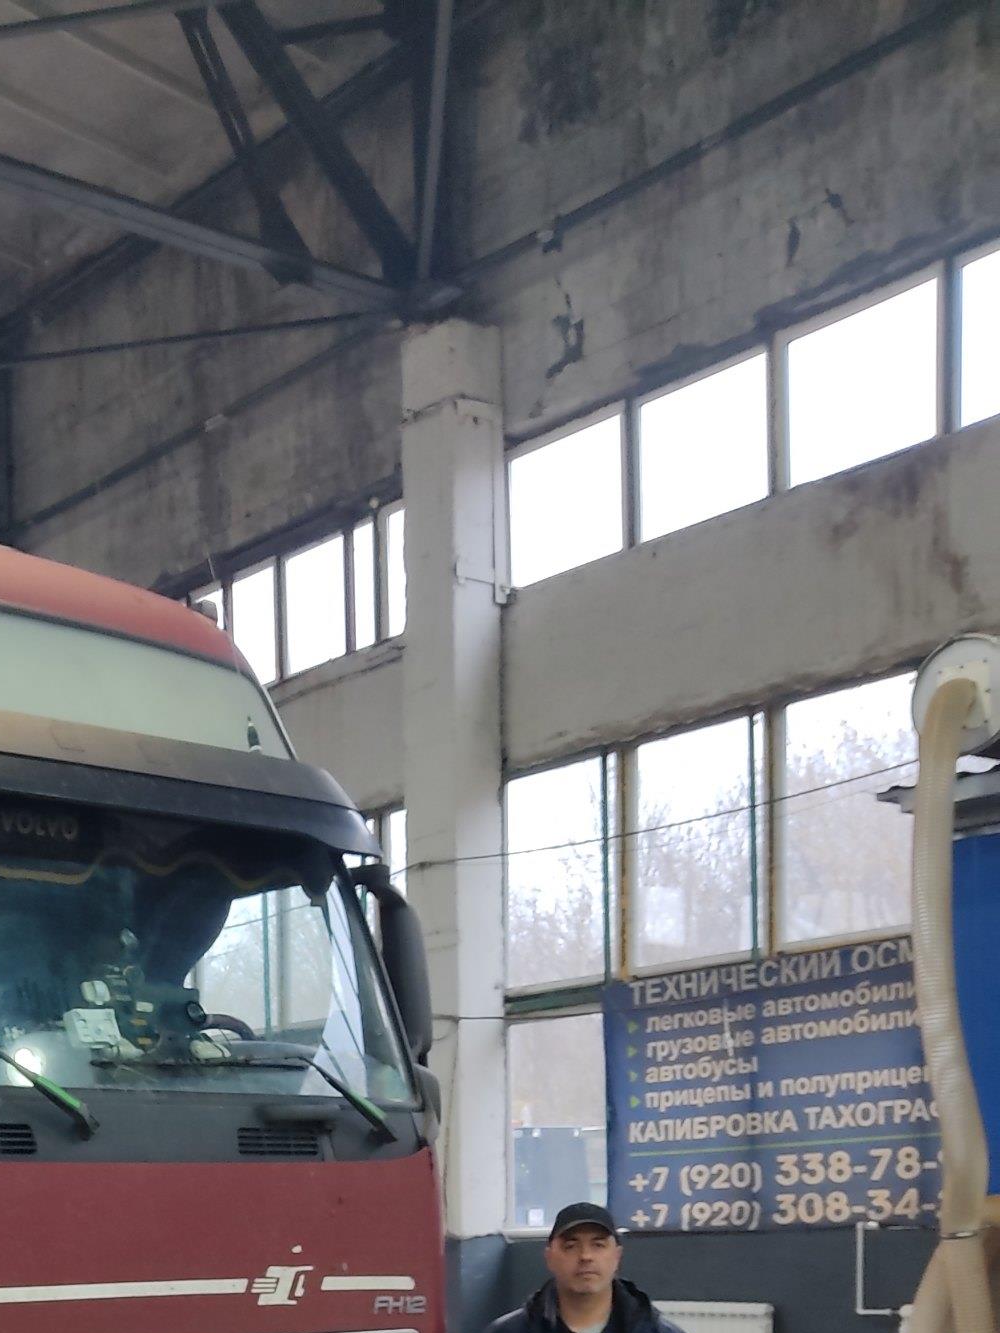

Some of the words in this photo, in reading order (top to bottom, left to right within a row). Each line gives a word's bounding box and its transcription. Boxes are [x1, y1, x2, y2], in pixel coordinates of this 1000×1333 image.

[0, 810, 80, 842] VOLVO
[629, 950, 842, 1006] ТЕХНИЧЕСКИЙ
[645, 1001, 757, 1034] легковые
[645, 1055, 759, 1084] автобусы
[645, 1083, 752, 1113] прицепы
[758, 1080, 775, 1099] и
[780, 1065, 929, 1099] полуприце
[628, 1108, 799, 1144] КАЛИБРОВКА
[628, 1166, 670, 1193] +7
[679, 1162, 763, 1197] (920)
[775, 1146, 943, 1187] 338-78-
[630, 1203, 669, 1229] +7
[681, 1200, 762, 1232] (920)
[771, 1187, 943, 1226] 308-34-
[374, 1295, 427, 1315] FH12
